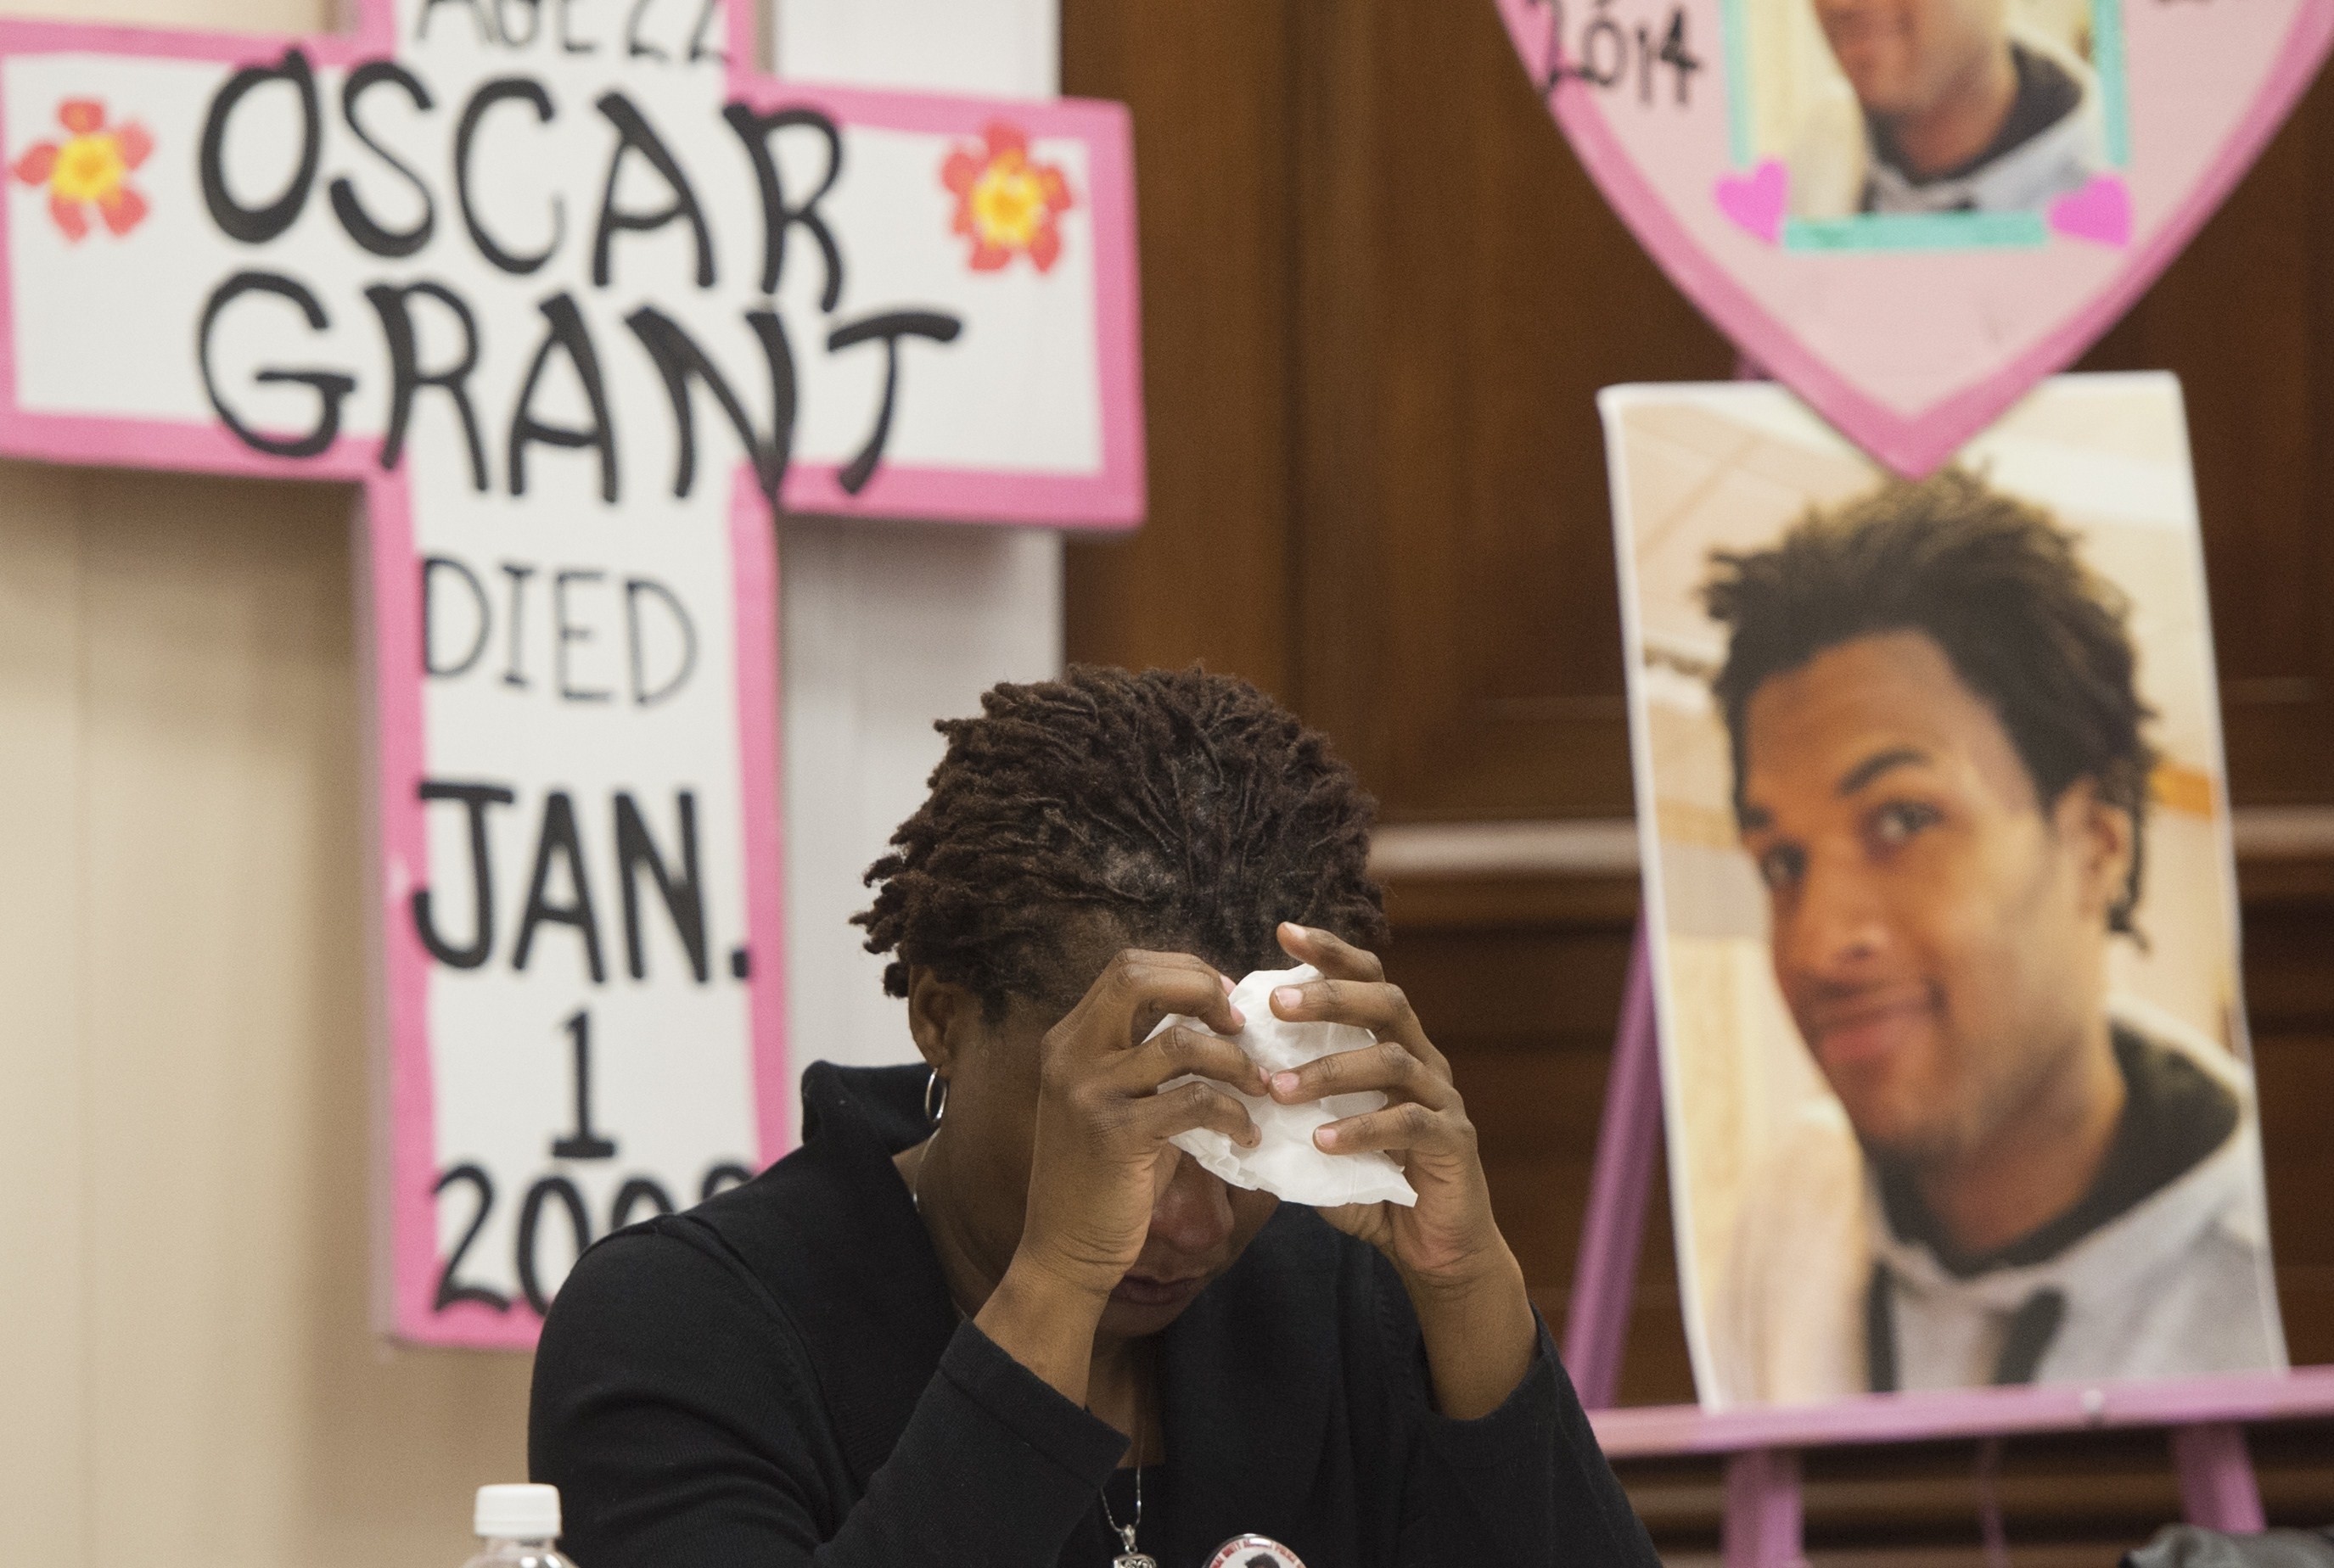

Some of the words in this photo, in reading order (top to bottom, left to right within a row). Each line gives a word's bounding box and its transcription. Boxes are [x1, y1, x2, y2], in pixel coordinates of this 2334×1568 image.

[199, 49, 844, 312] OSCAR
[199, 270, 962, 507] GRANT
[420, 555, 699, 706] DIED
[412, 780, 750, 984] JAN.
[552, 1008, 618, 1159] 1
[431, 1162, 752, 1320] 20
